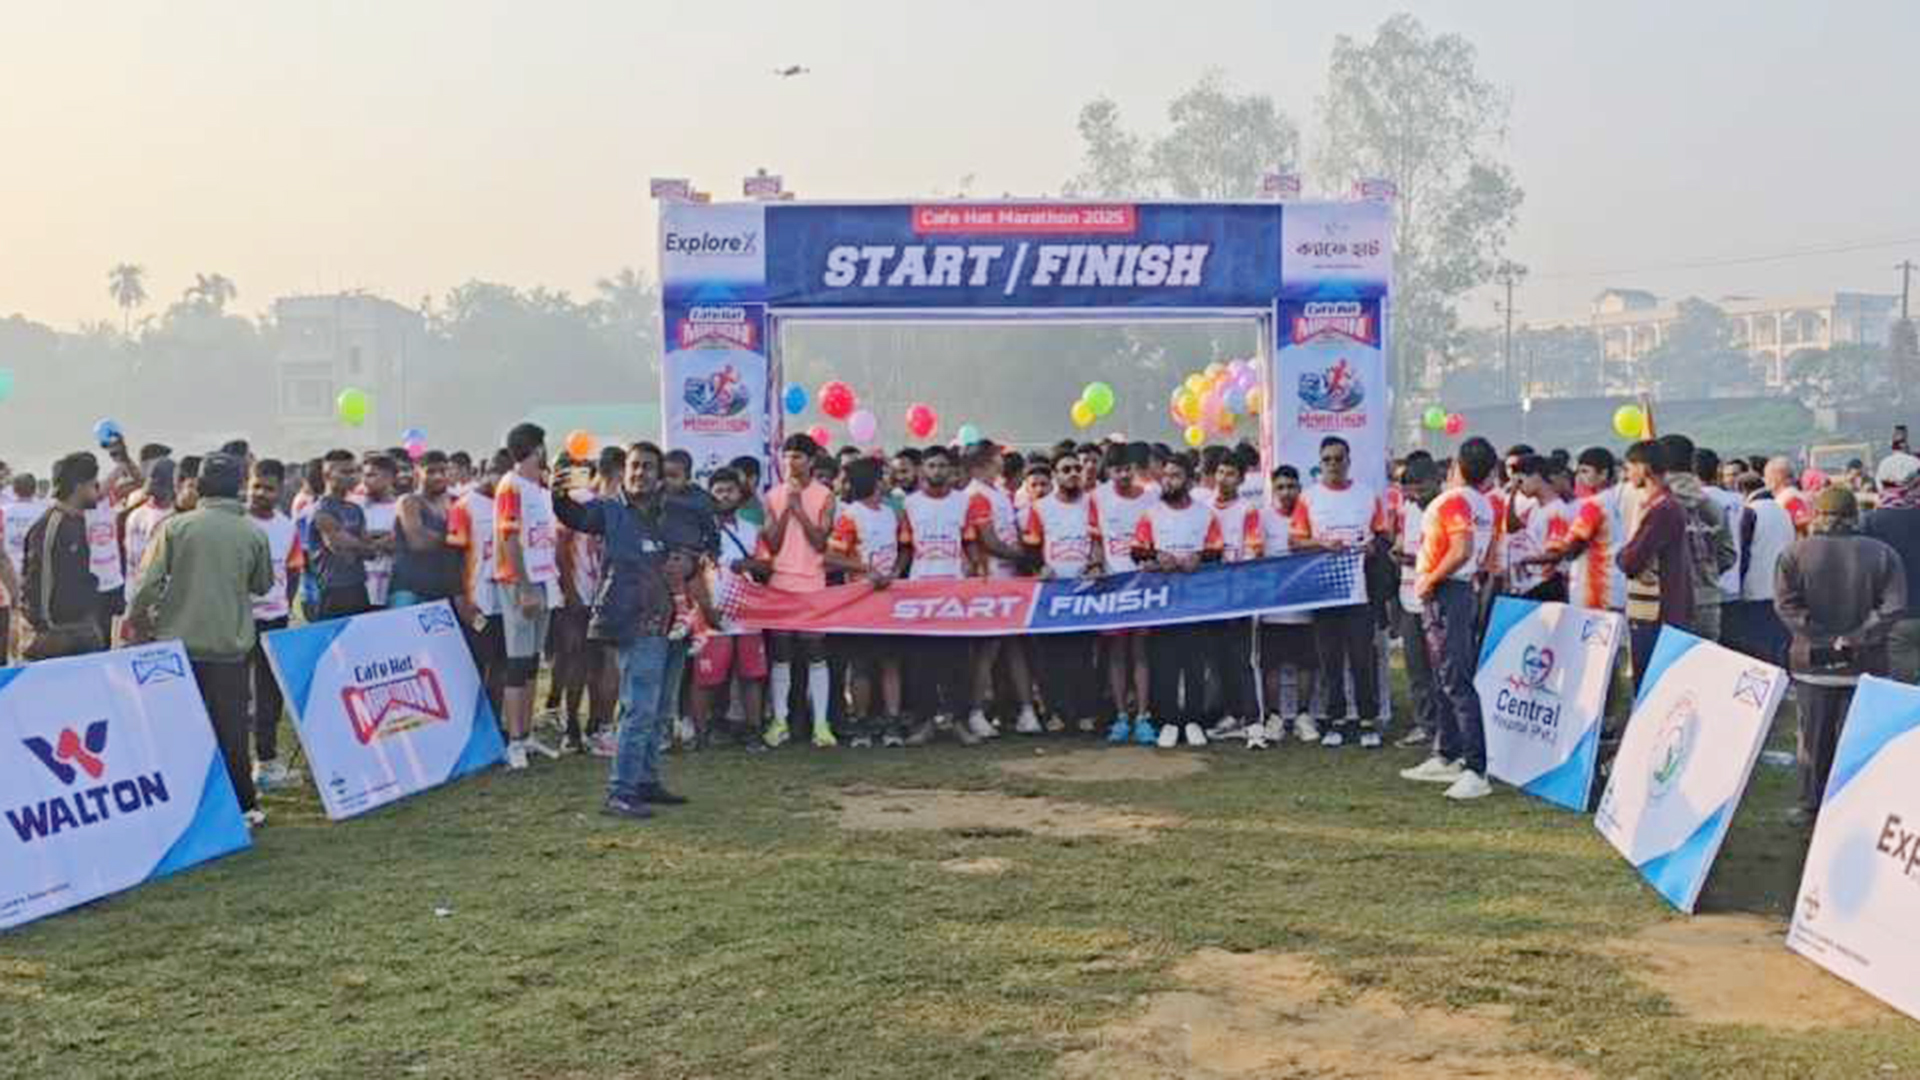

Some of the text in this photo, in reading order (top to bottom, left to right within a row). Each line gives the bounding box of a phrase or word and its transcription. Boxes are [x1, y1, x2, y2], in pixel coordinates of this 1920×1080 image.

[920, 208, 1125, 226] Cafe Hat Marathon 2025
[824, 245, 1003, 288] START
[1031, 244, 1209, 287] FINISH
[891, 586, 1169, 619] START FINISH
[1496, 688, 1561, 728] Central
[5, 771, 170, 843] WALTON
